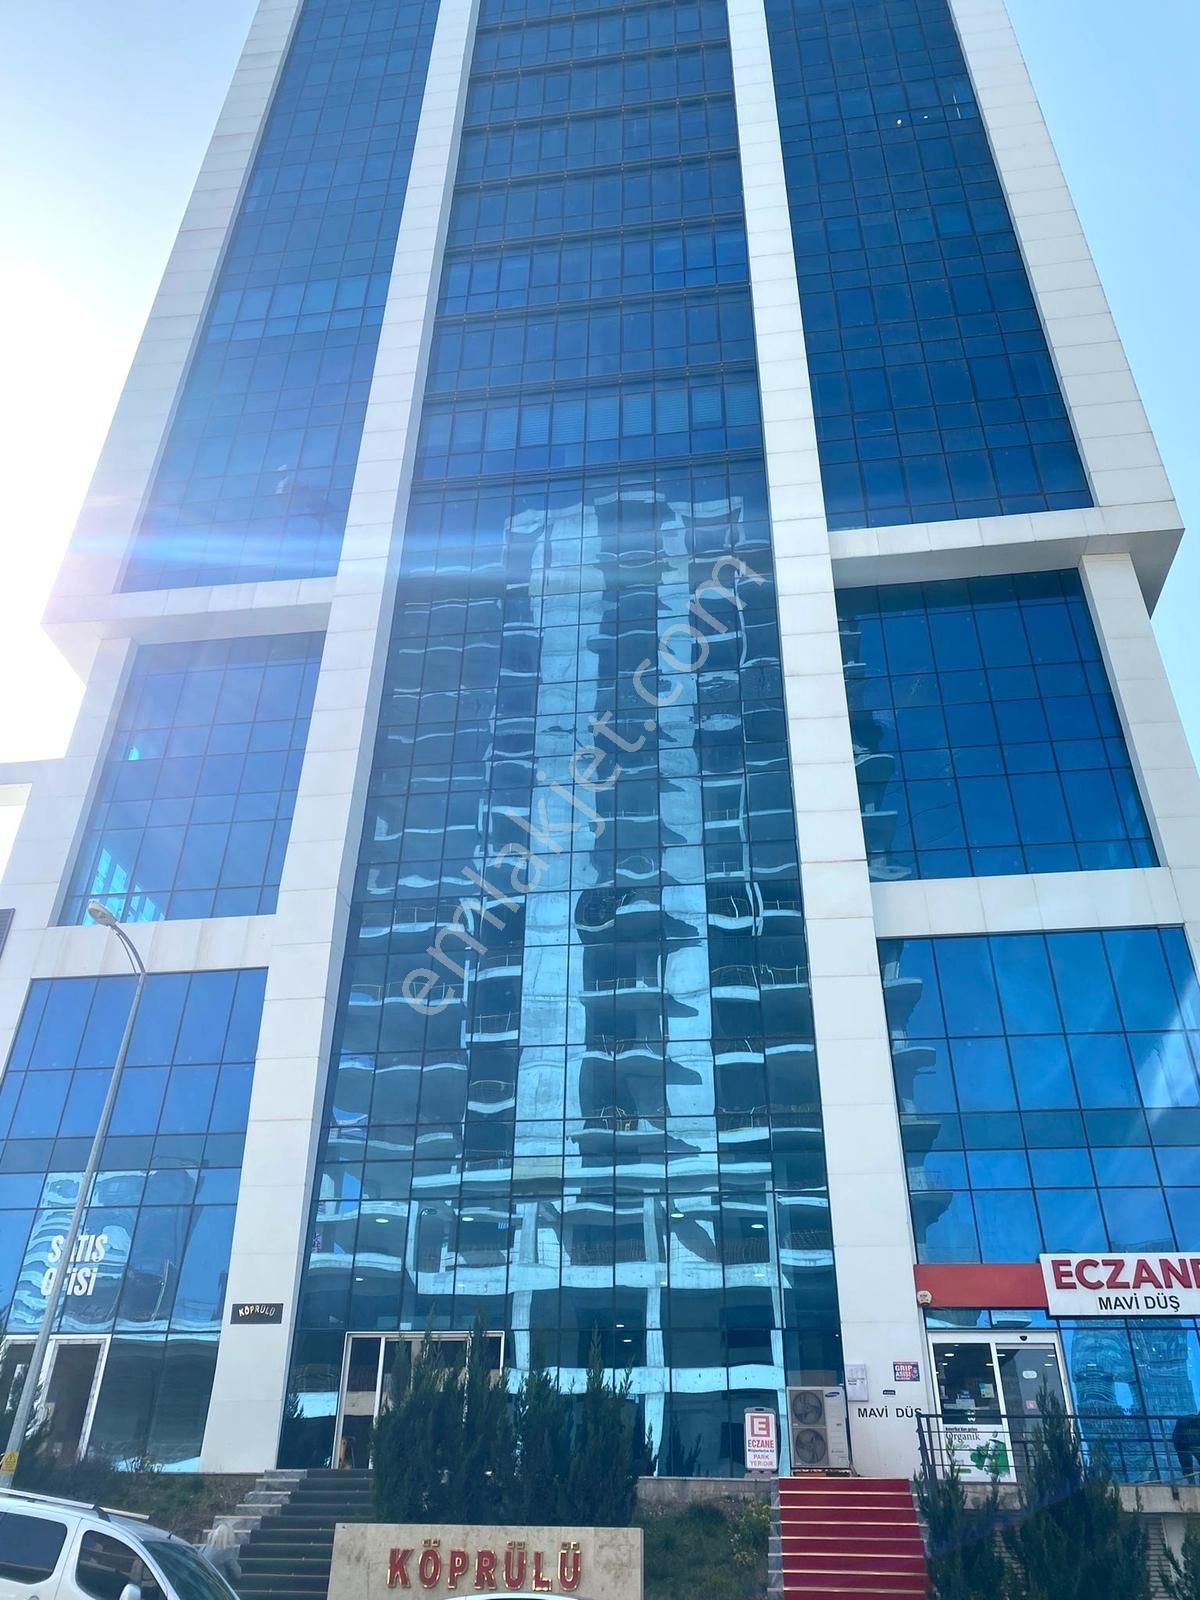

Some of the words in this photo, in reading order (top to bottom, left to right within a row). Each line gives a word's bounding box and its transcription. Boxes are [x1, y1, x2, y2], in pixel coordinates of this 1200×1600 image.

[1098, 1292, 1140, 1310] MAVİ
[1144, 1292, 1180, 1312] DÜŞ
[857, 1405, 889, 1418] MAVİ
[747, 1439, 775, 1449] ECZANE
[386, 1538, 582, 1592] KÖPRÜLÜ
